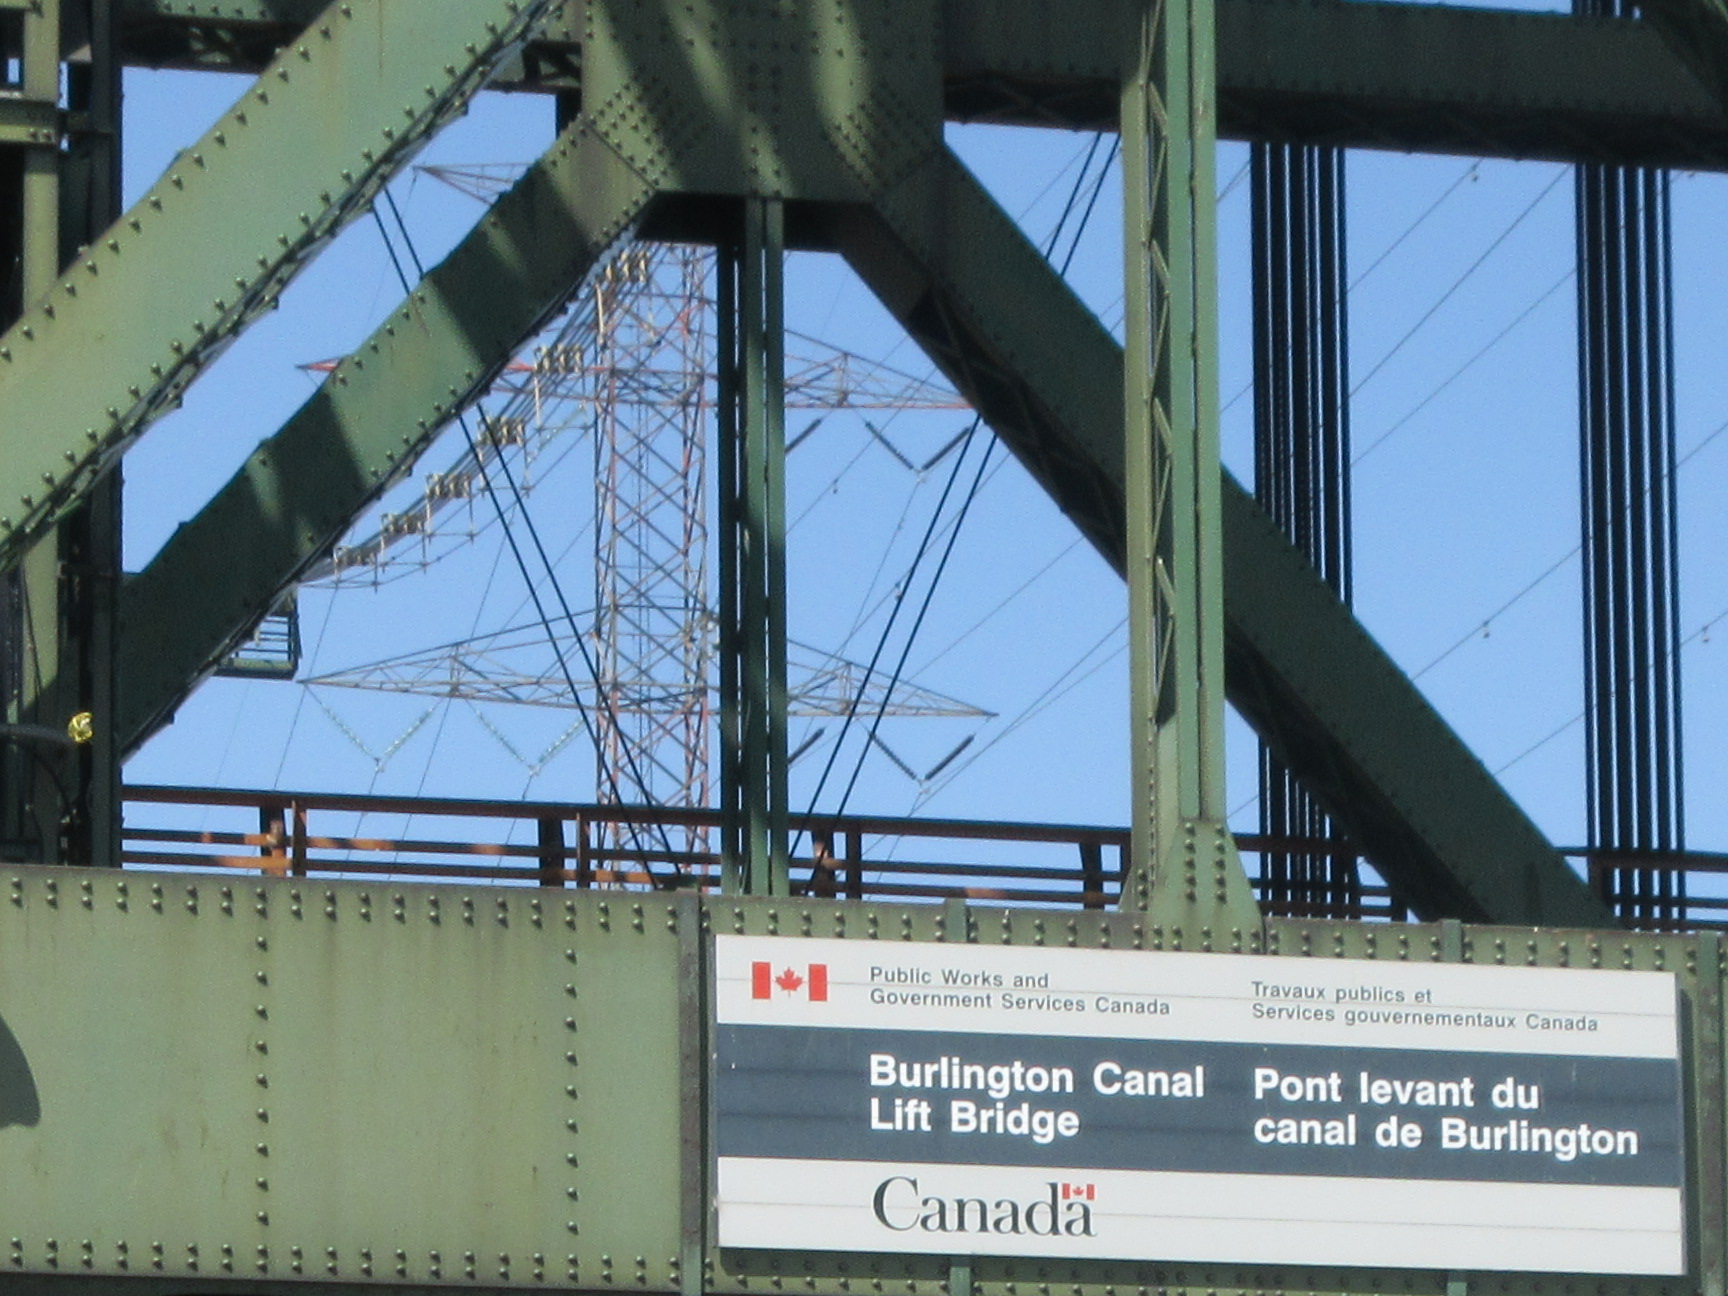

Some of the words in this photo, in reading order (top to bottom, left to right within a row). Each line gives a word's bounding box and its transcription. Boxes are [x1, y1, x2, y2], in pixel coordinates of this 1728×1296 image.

[870, 966, 932, 984] Public
[941, 968, 1004, 988] Works
[1013, 972, 1049, 989] and
[1251, 980, 1326, 1000] Travaux
[1335, 985, 1405, 1004] publics
[1414, 988, 1432, 1003] et
[870, 988, 992, 1008] Government
[1001, 992, 1086, 1012] Services
[1095, 996, 1171, 1015] Canada
[1251, 1002, 1335, 1023] Services
[1344, 1008, 1517, 1029] gouvernementaux
[1526, 1013, 1599, 1032] Canada
[869, 1053, 1074, 1099] Burlington
[1093, 1061, 1205, 1098] Canal
[1253, 1067, 1342, 1103] Pont
[1360, 1071, 1474, 1107] levant
[1492, 1076, 1540, 1110] du
[870, 1097, 932, 1132] Lift
[950, 1100, 1081, 1144] Bridge
[1253, 1113, 1357, 1146] canal
[1375, 1115, 1423, 1148] de
[1441, 1117, 1640, 1161] Burlington
[872, 1176, 1099, 1238] Canada
